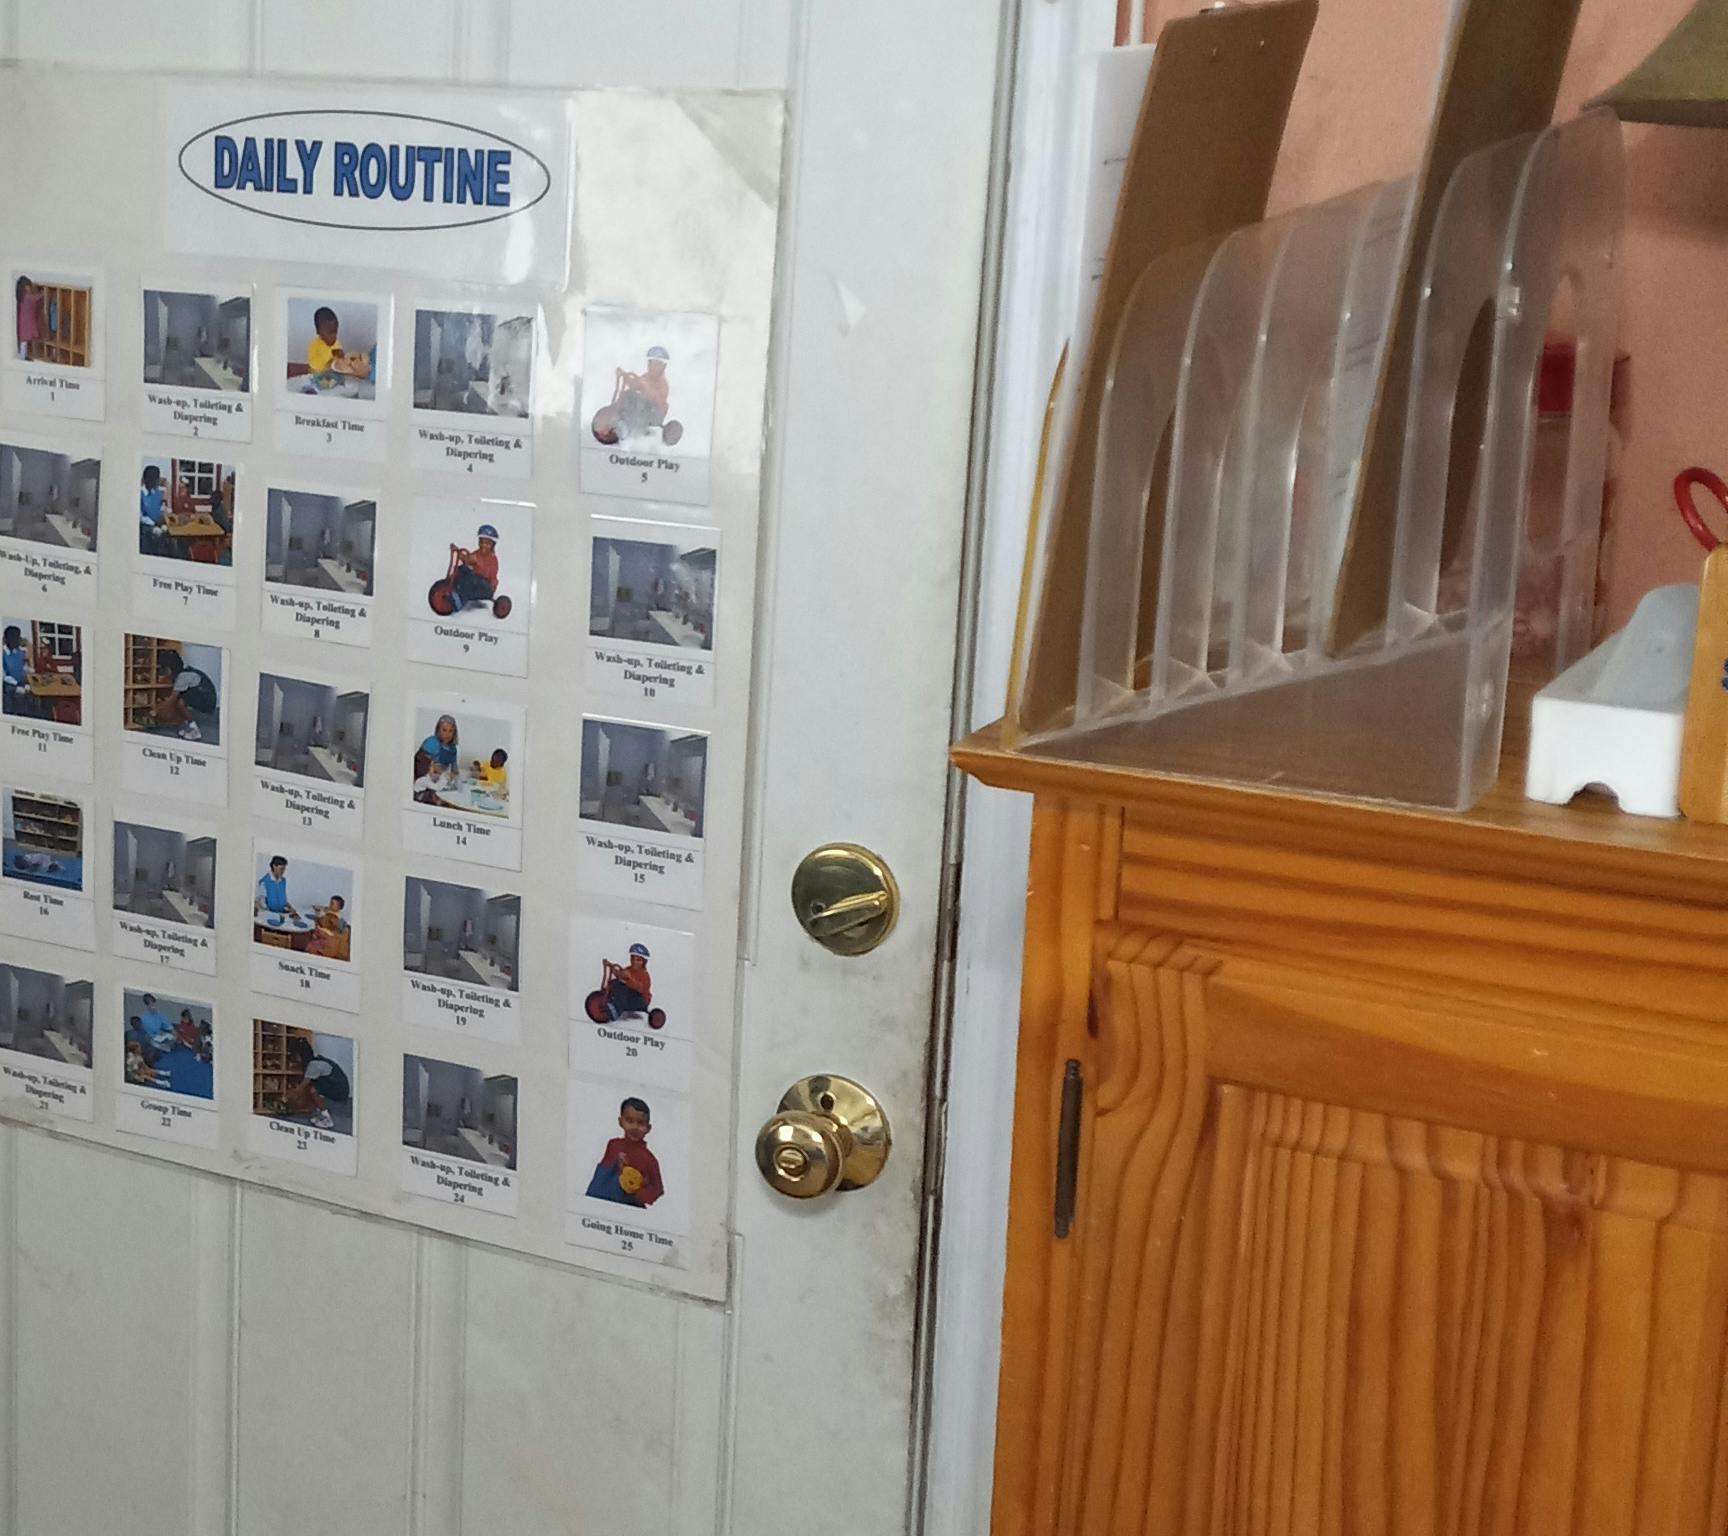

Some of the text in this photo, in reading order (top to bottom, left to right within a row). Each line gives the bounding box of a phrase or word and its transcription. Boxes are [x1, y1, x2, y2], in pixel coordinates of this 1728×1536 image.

[213, 135, 513, 207] DAILY ROUTINE
[25, 375, 79, 390] Arrival Time
[192, 398, 232, 413] Toileting
[234, 402, 243, 412] &
[173, 408, 217, 426] Diapering
[294, 415, 364, 432] Breakfast Time
[467, 433, 510, 450] Toileting
[513, 438, 522, 448] &
[445, 446, 494, 463] Diapering
[608, 453, 679, 472] Outdoor Play
[23, 566, 65, 585] Diapering
[83, 565, 91, 575] &
[152, 577, 218, 596] Free Play Time
[315, 600, 356, 618] Toileting
[357, 607, 366, 617] &
[295, 611, 340, 629] Diapering
[433, 625, 498, 645] Outdoor Play
[646, 657, 692, 675] Toileting
[694, 664, 704, 674] &
[623, 669, 675, 688] Diapering
[10, 724, 73, 744] Free Play Time
[141, 747, 206, 767] Clean Up Time
[285, 798, 329, 819] Diapering
[304, 789, 345, 809] Toileting
[346, 799, 355, 809] &
[432, 817, 491, 835] Lunch Time
[636, 843, 682, 863] Toileting
[684, 852, 694, 863] &
[614, 854, 664, 875] Diapering
[23, 890, 63, 906] Rest Time
[143, 938, 185, 957] Diapering
[160, 929, 198, 947] Toileting
[199, 938, 208, 947] &
[278, 960, 330, 980] Snack Time
[437, 997, 484, 1018] Diapering
[457, 988, 500, 1008] Toileting
[502, 998, 511, 1008] &
[597, 1027, 665, 1050] Outdoor Play
[24, 1083, 64, 1104] Diapering
[41, 1075, 77, 1094] Toileting
[79, 1085, 86, 1094] &
[139, 1099, 191, 1117] Group Time
[269, 1120, 335, 1143] Clean Up Time
[436, 1174, 483, 1196] Diapering
[456, 1165, 499, 1185] Toileting
[501, 1176, 510, 1186] &
[581, 1217, 673, 1246] Going Home Time
